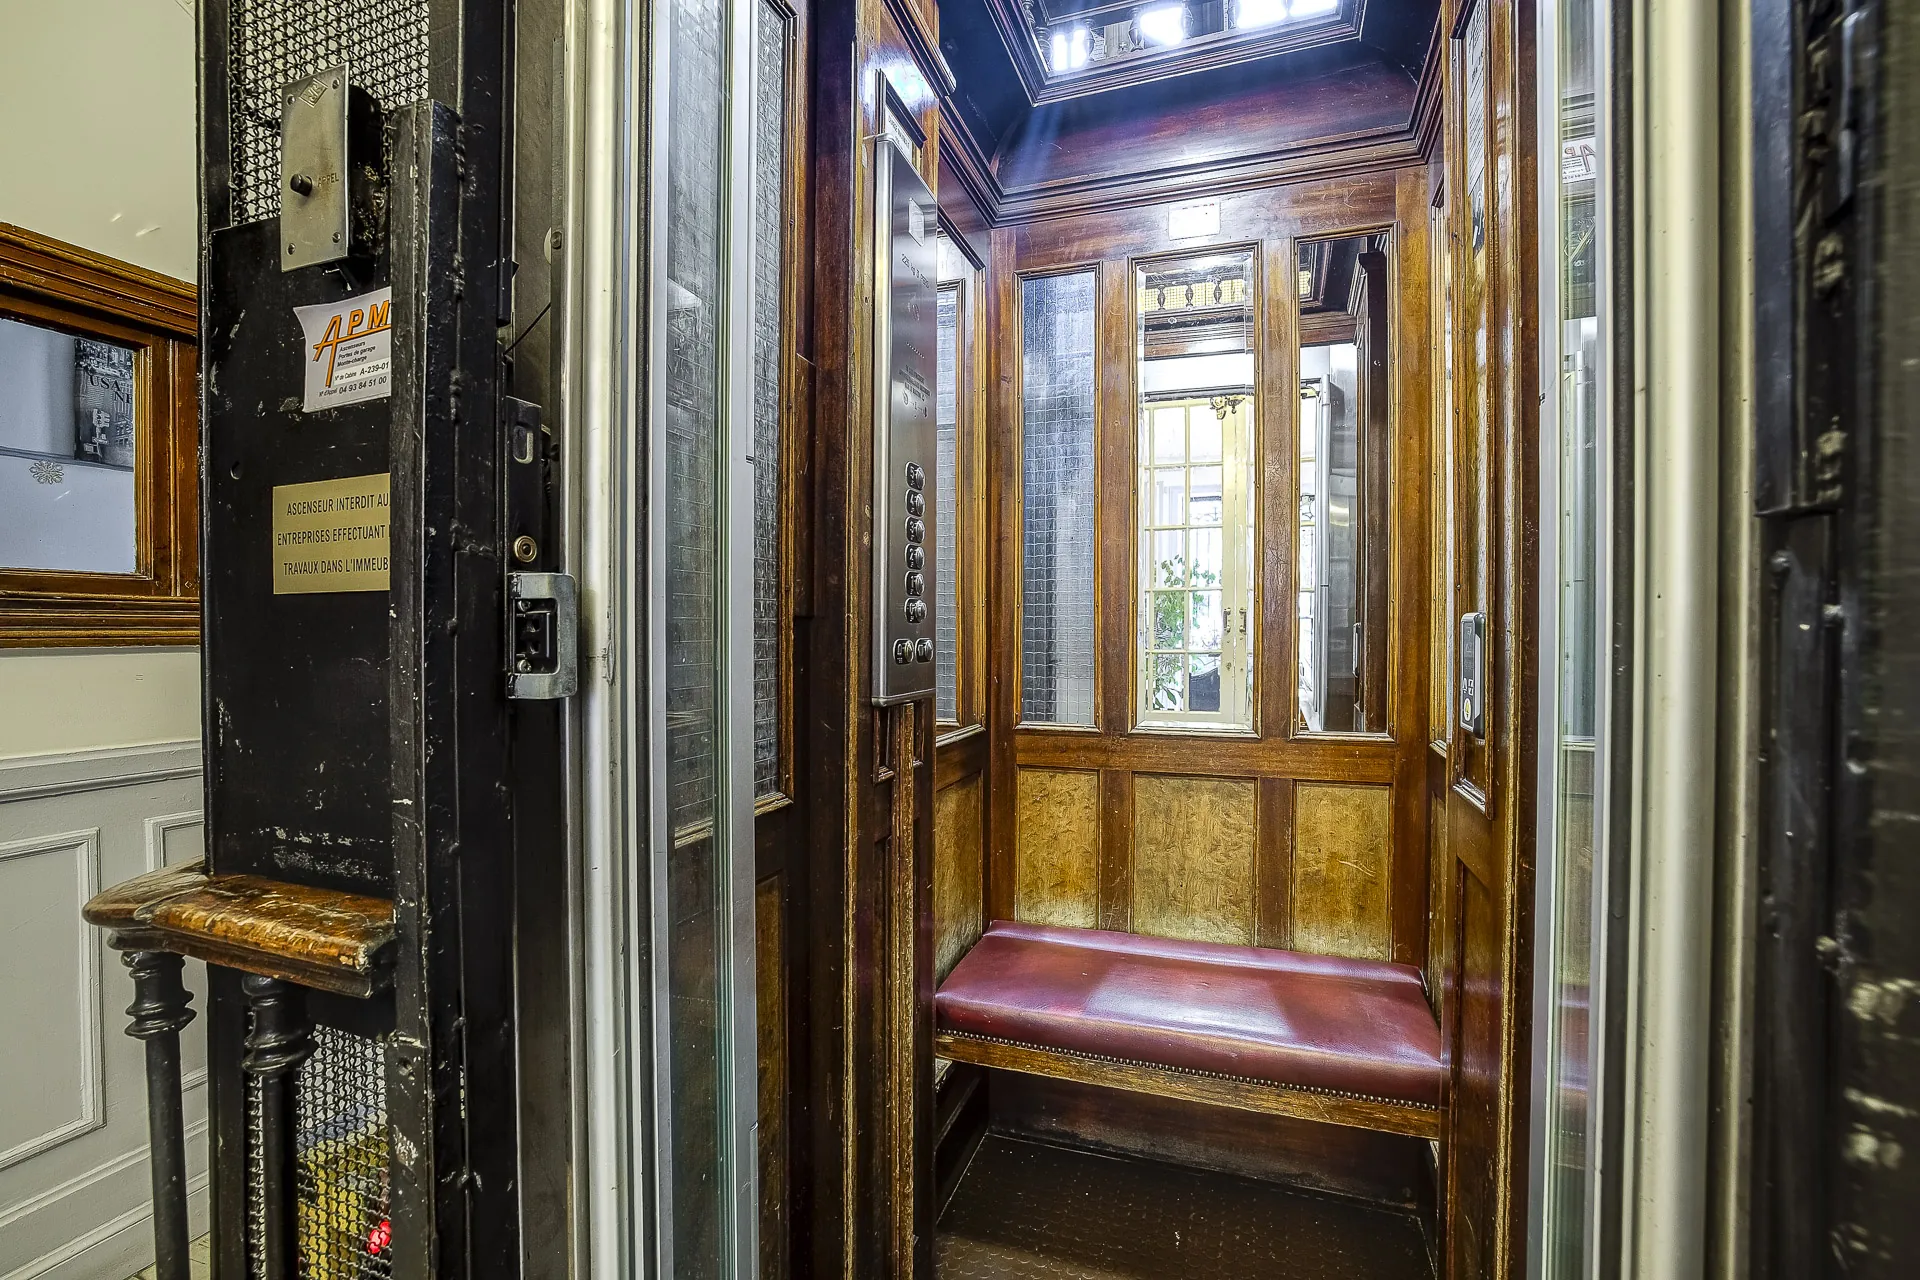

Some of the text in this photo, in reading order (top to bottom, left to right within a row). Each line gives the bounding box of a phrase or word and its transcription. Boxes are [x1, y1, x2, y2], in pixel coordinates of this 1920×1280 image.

[317, 172, 339, 187] APPEL
[312, 299, 391, 388] APM
[339, 341, 366, 352] Ascenseurs
[336, 355, 367, 368] Monte-charge
[338, 351, 353, 360] Portes
[360, 346, 376, 355] garage
[345, 371, 357, 379] Cabine
[360, 361, 390, 376] A-239-01
[89, 374, 121, 392] USA
[338, 386, 348, 394] 04
[348, 383, 358, 392] 93
[358, 380, 367, 389] 84
[368, 378, 376, 387] 51
[378, 375, 387, 385] 00
[286, 492, 390, 516] ASCENSEUR INTERDIT AU
[277, 529, 330, 546] ENTREPRISES
[332, 524, 386, 542] EFFECTUANT
[284, 561, 320, 576] TRAVAUX
[321, 559, 343, 574] DANS
